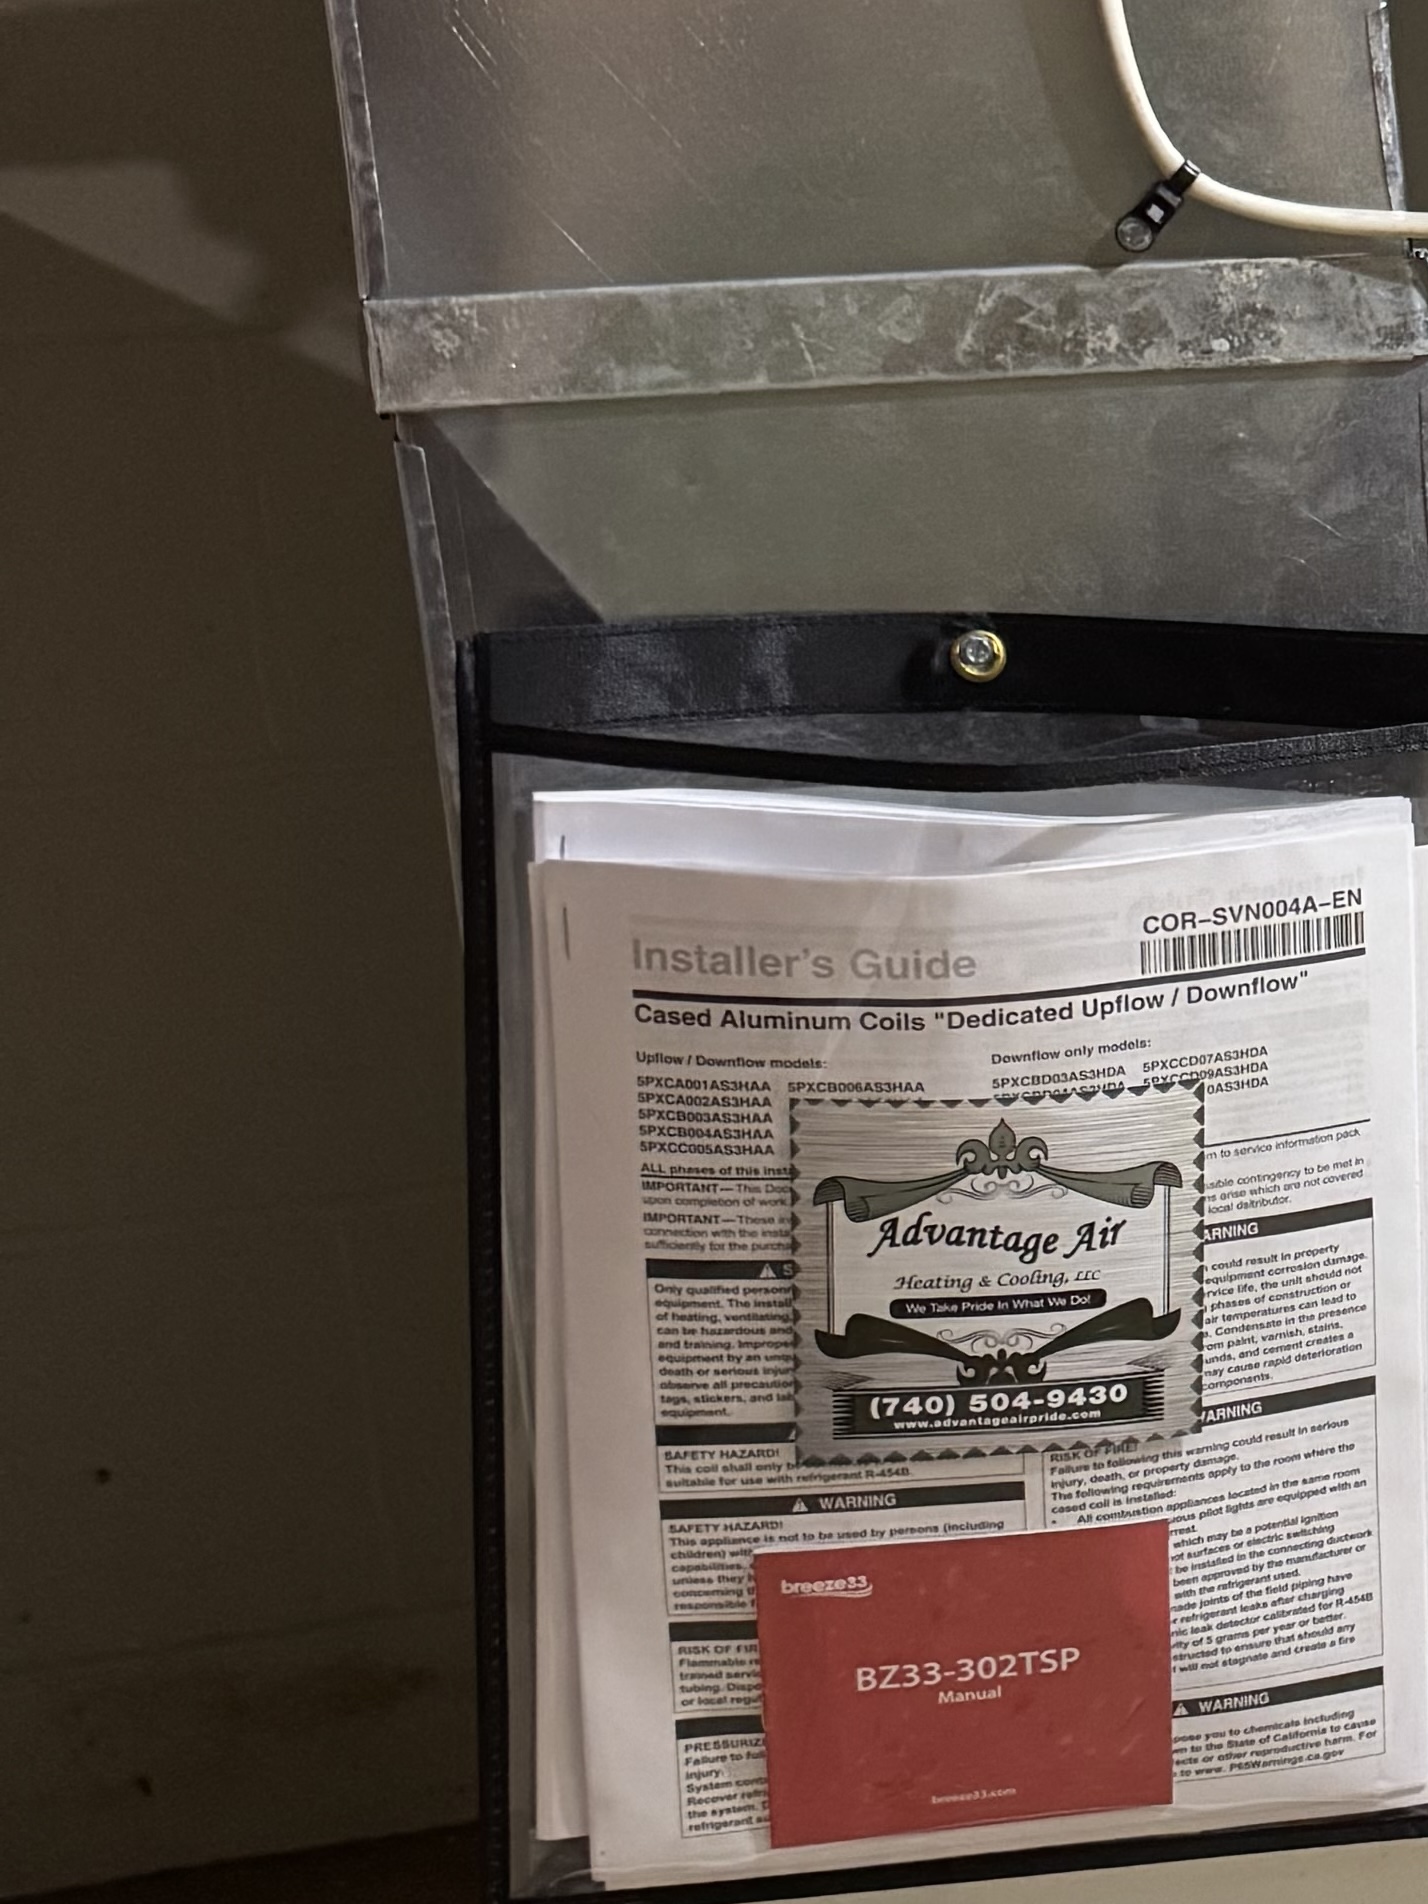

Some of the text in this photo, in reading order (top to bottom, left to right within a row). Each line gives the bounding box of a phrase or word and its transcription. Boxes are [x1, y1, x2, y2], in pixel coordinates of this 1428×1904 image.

[1142, 888, 1363, 934] COR-SVN004A-EN
[632, 938, 978, 980] Installer's Guide
[634, 970, 1309, 1031] Cased Aluminum Coils "Dedicated Upflow / Downflow"
[636, 1051, 828, 1070] Upflow / Downflow models:
[991, 1038, 1152, 1065] Downflow only models:
[866, 1211, 1127, 1264] Advantage Air
[1203, 1222, 1259, 1243] ARNING
[1210, 1243, 1340, 1272] could result in property
[893, 1274, 973, 1293] Heating
[978, 1276, 992, 1288] &
[997, 1270, 1070, 1288] Cooling,
[1205, 1269, 1265, 1288] equipment
[1262, 1265, 1363, 1290] the unit should not
[906, 1294, 1091, 1314] We Take Pride In What We Do!
[1210, 1280, 1351, 1314] phases of construction or
[870, 1384, 1128, 1420] (740) 504-9430
[894, 1408, 1101, 1430] www.advantageairpride.com
[819, 1493, 897, 1511] WARNING
[669, 1520, 784, 1534] SAFETY HAZARD!
[670, 1518, 1004, 1548] This appliance is not to be used by persons (including
[856, 1647, 1081, 1692] BZ33-302TSP
[938, 1686, 1002, 1705] Manual
[1199, 1692, 1270, 1714] WARNING
